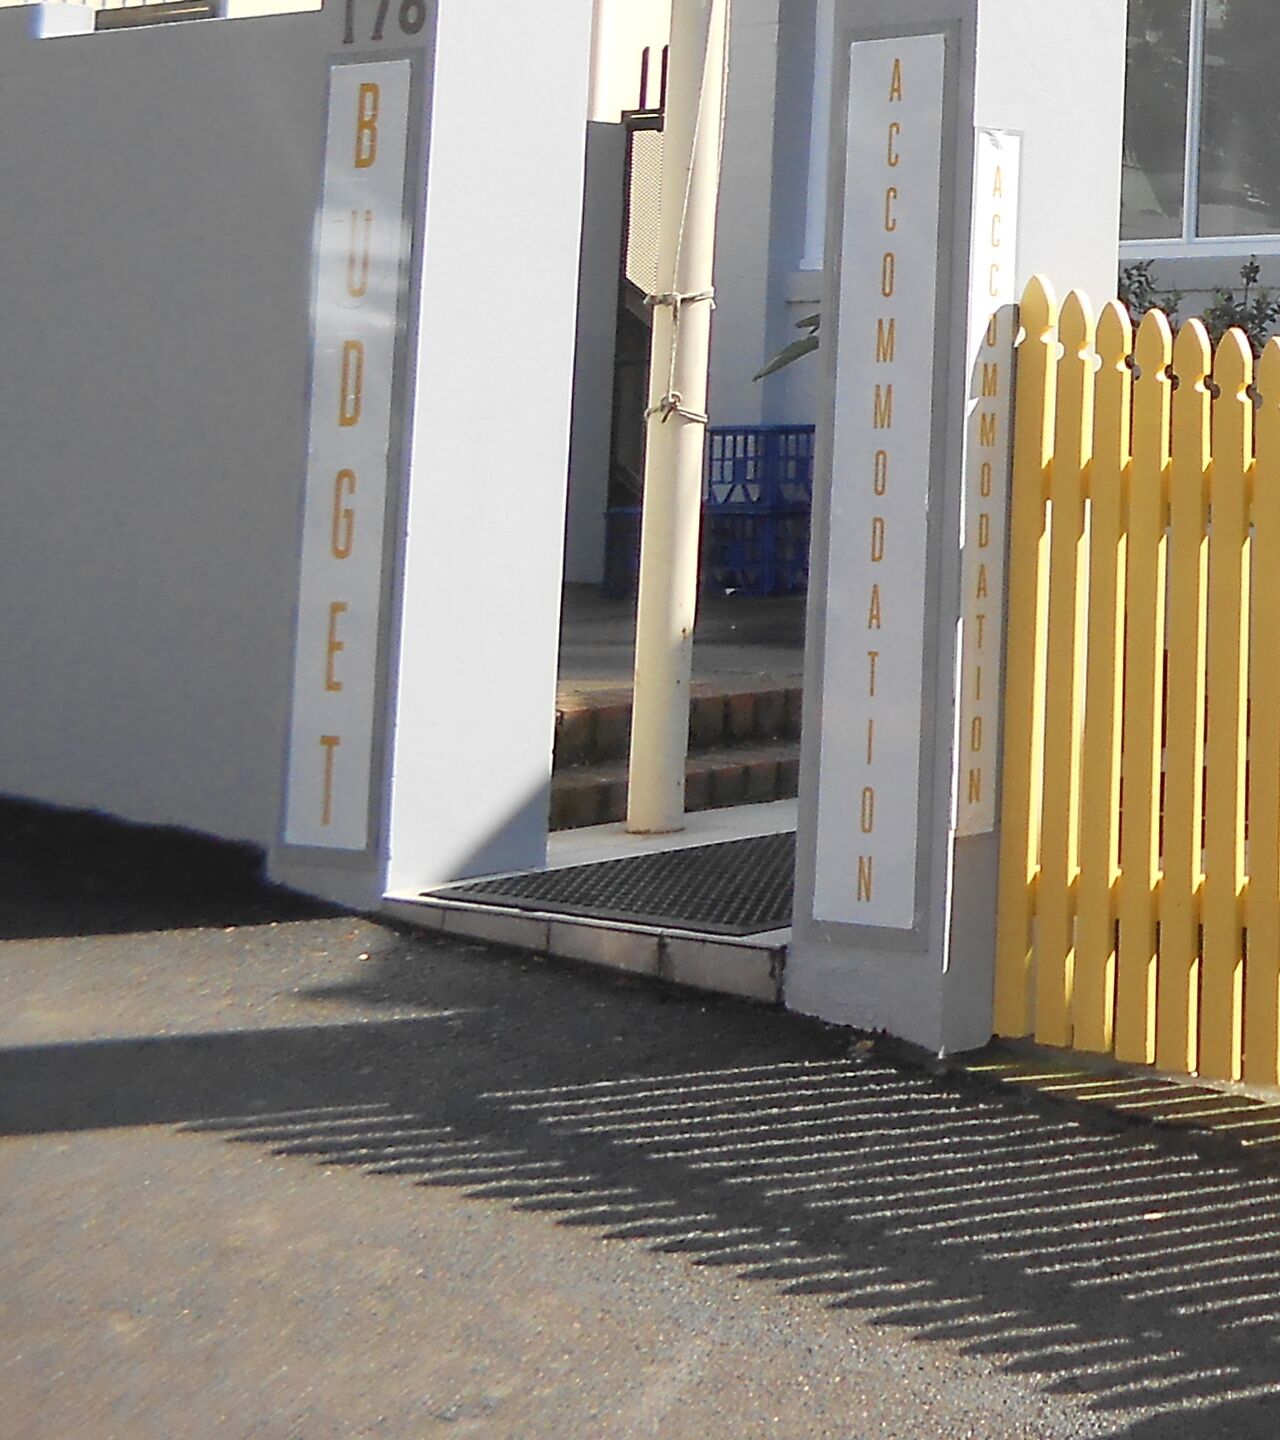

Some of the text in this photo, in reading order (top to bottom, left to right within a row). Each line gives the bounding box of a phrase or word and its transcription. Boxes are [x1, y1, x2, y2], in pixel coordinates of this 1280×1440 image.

[319, 82, 381, 827] BUDGET
[855, 58, 905, 904] ACCOMMODATION
[967, 164, 1004, 805] ACCOMMODATION
